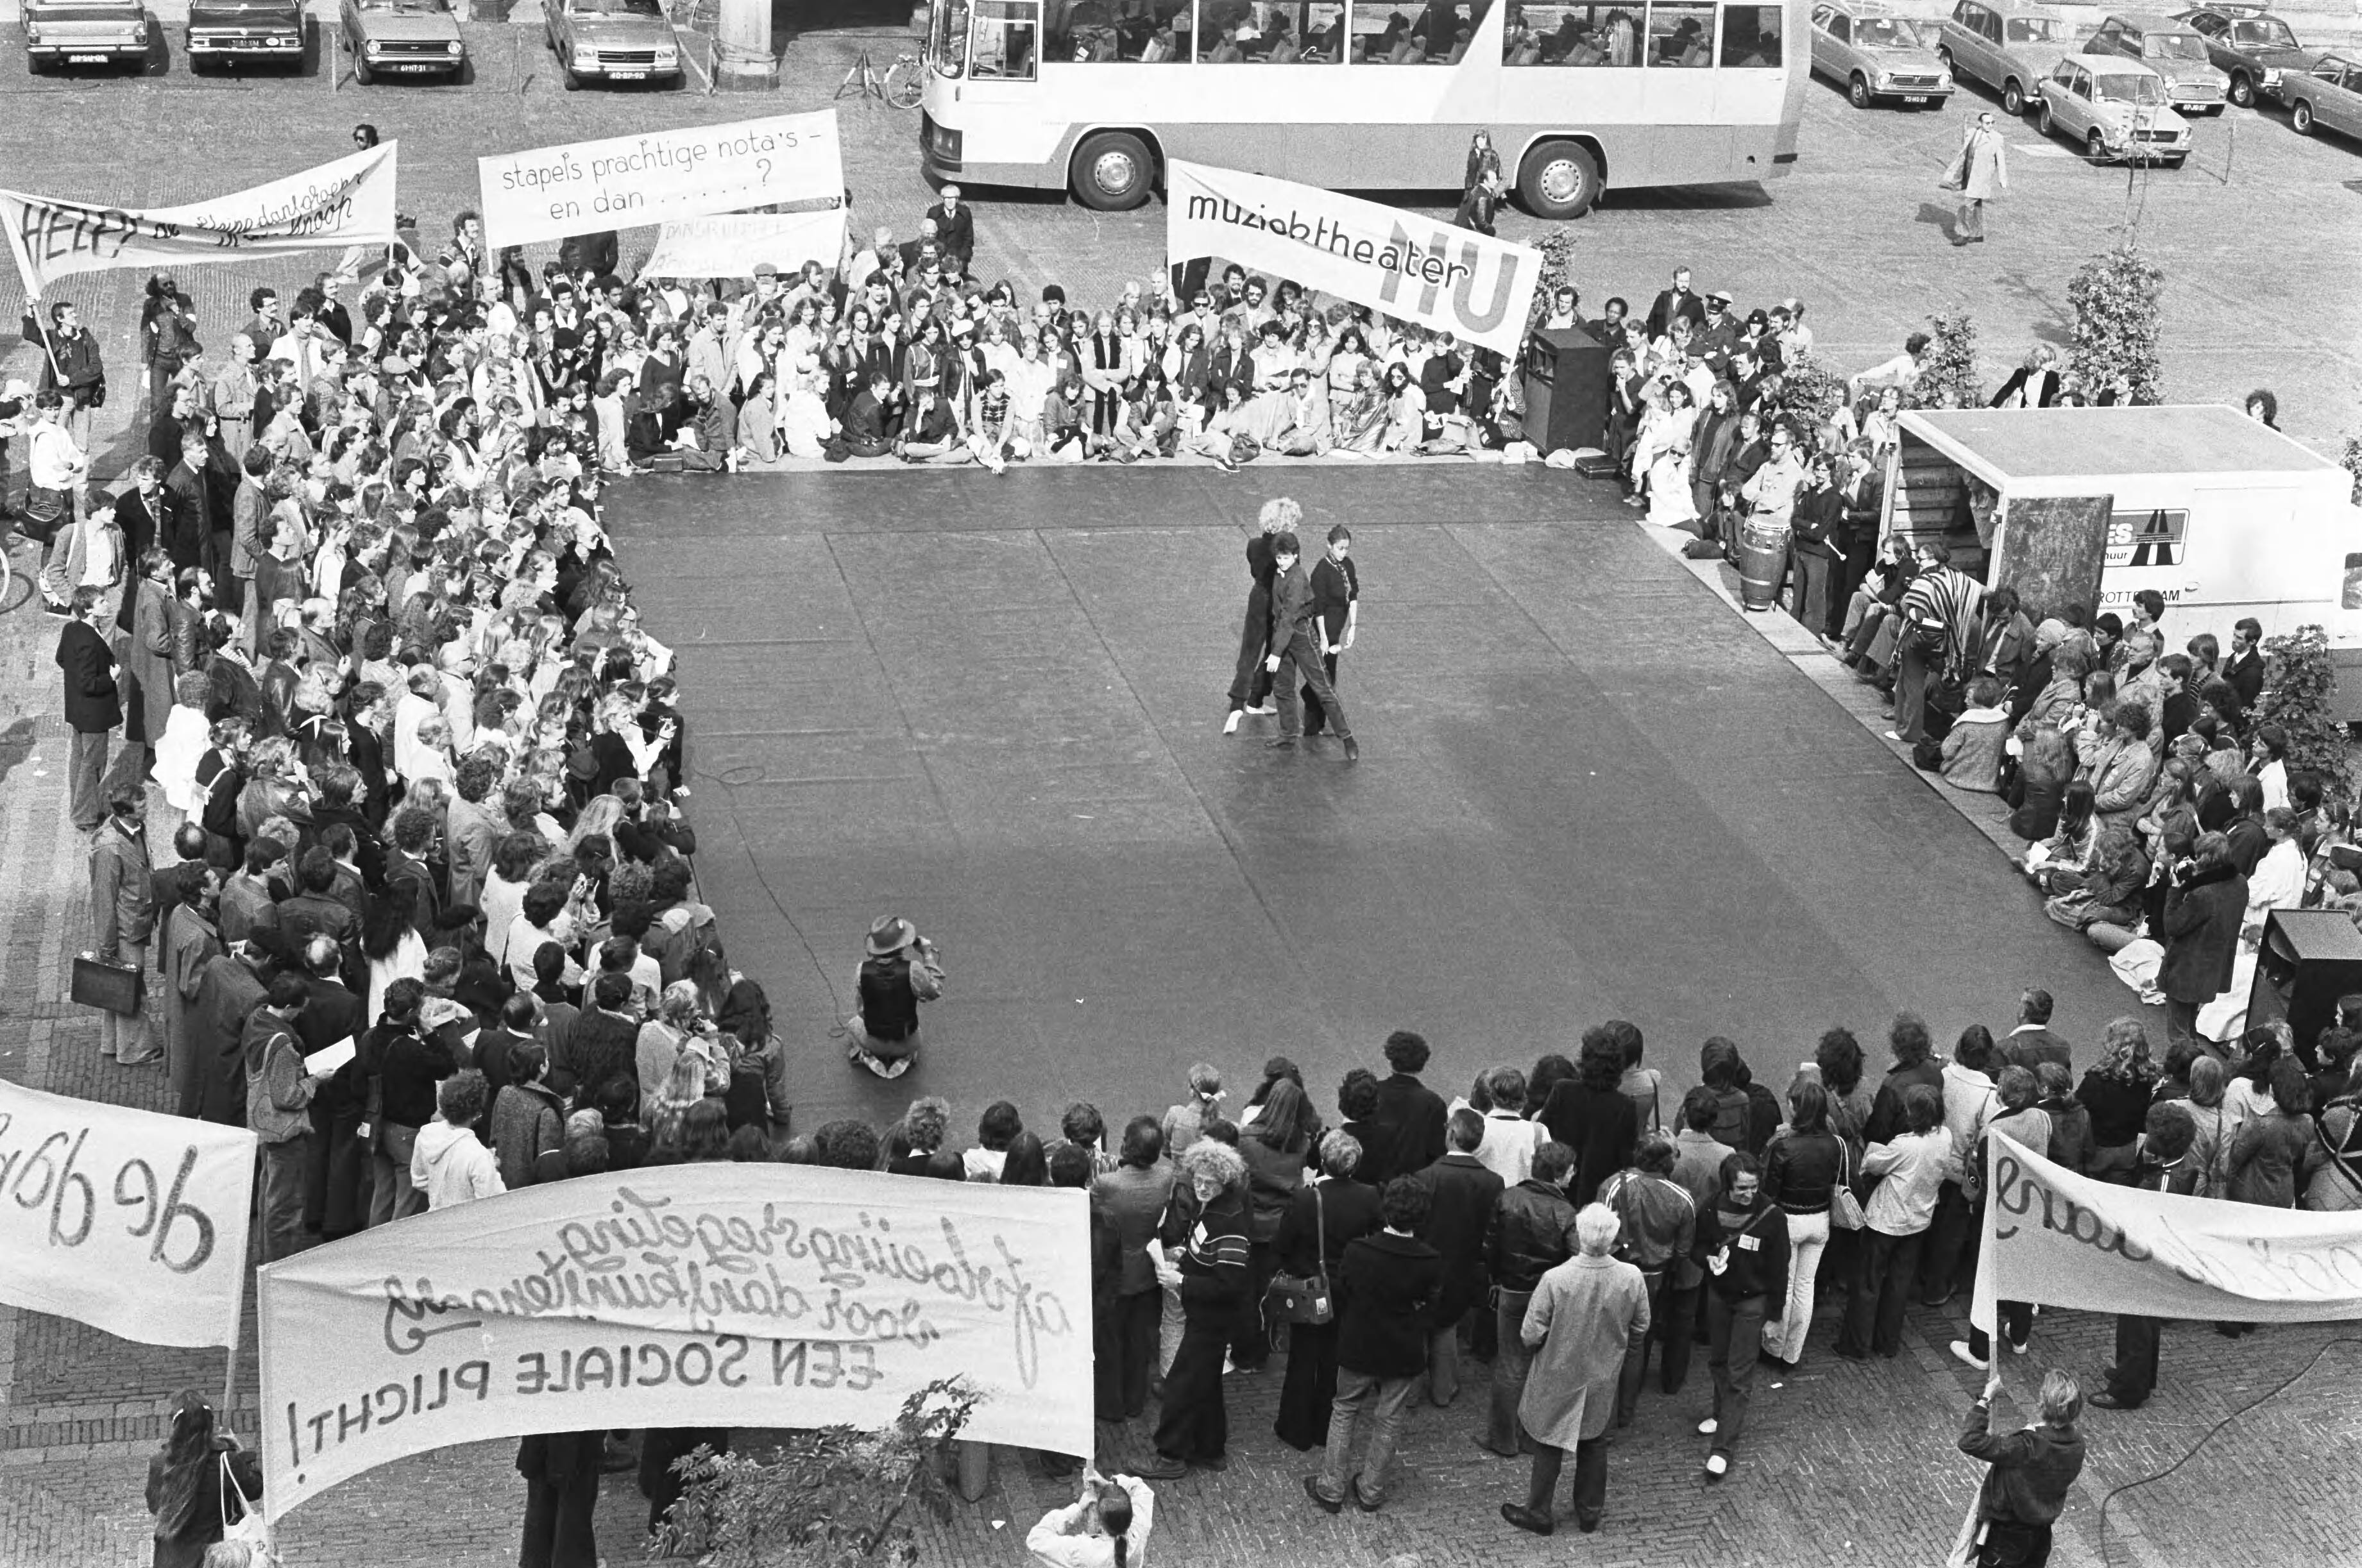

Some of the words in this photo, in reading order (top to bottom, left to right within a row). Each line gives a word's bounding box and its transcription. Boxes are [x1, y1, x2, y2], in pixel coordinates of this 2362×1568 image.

[502, 151, 582, 191] stapels
[591, 139, 708, 185] prachtige
[718, 130, 799, 158] nota's
[550, 201, 580, 220] en
[593, 189, 644, 214] dan
